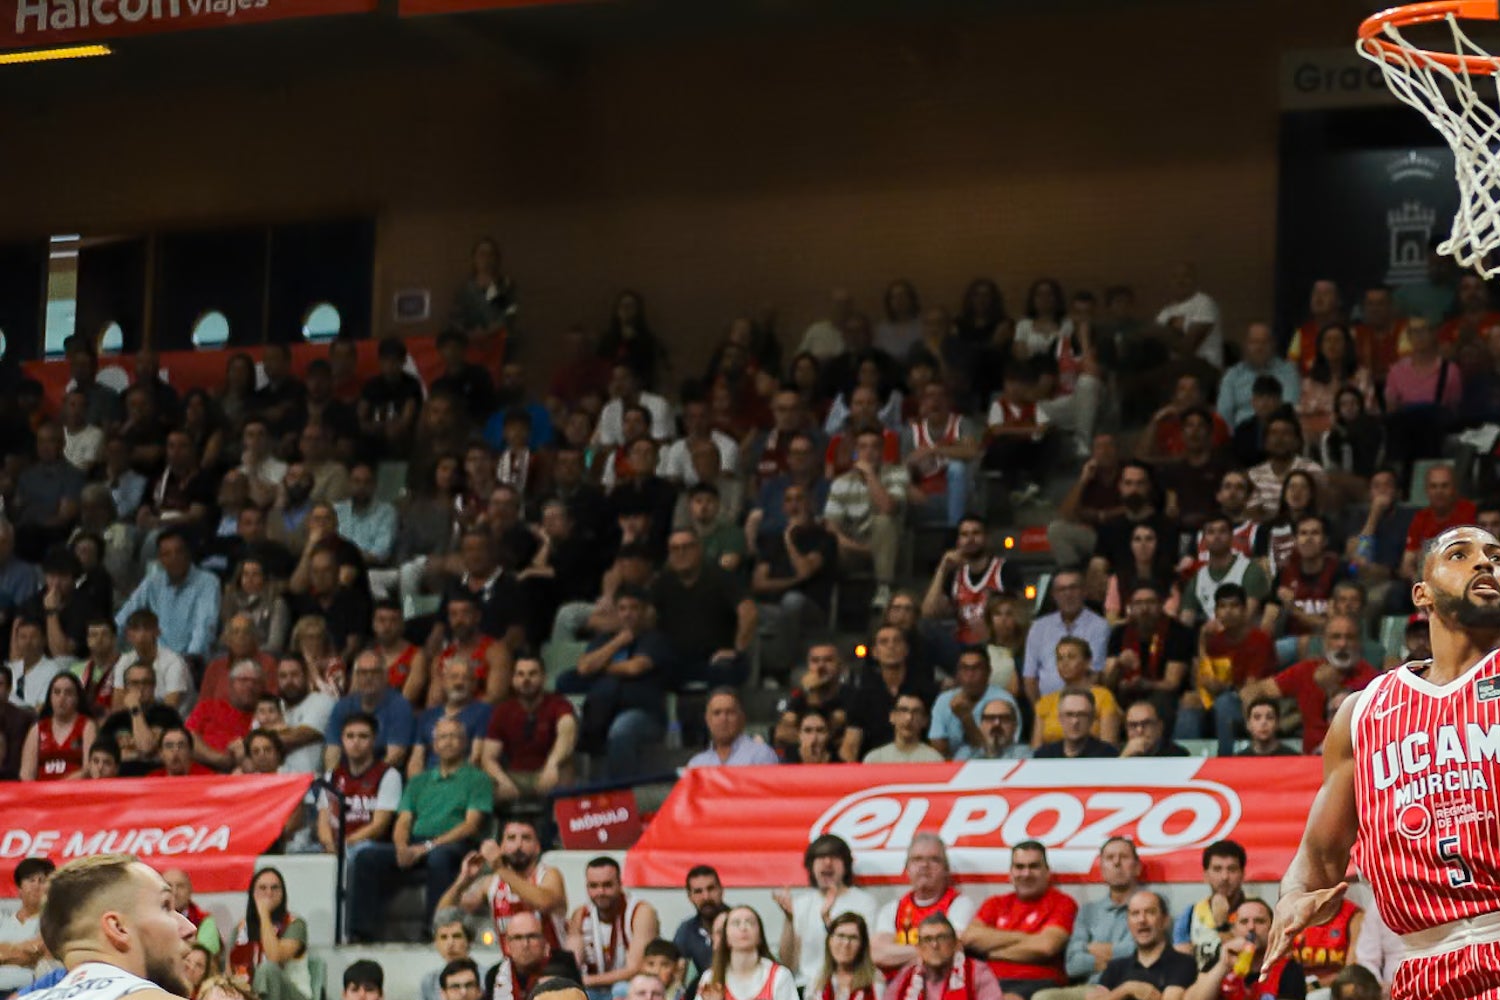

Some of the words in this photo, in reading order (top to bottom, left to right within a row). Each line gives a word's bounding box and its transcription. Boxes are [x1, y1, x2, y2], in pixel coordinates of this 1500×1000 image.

[1394, 769, 1488, 810] MURCIA
[1, 829, 60, 858] DE
[63, 825, 230, 858] MURCIA
[1438, 836, 1474, 887] 5
